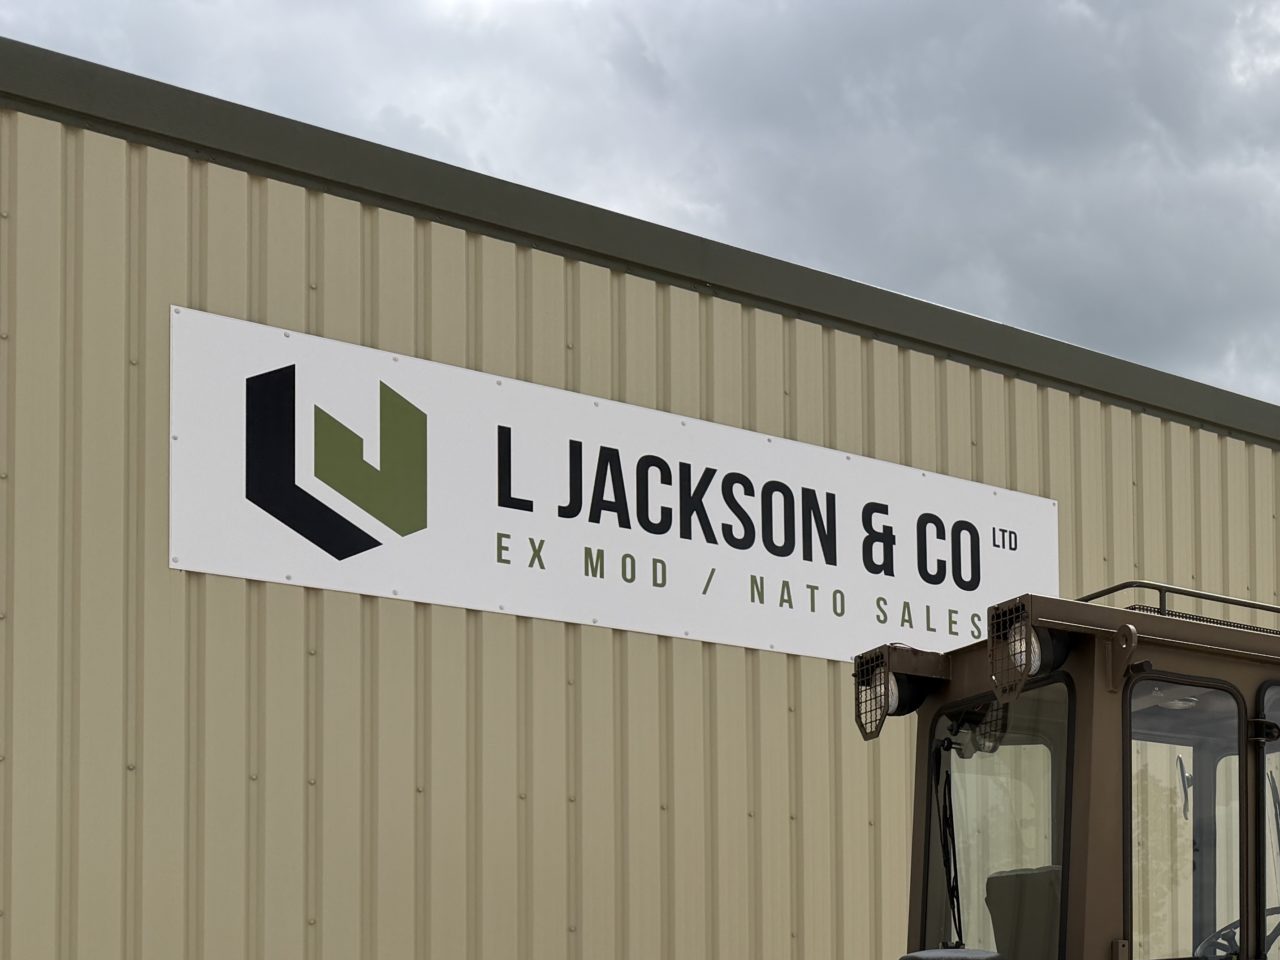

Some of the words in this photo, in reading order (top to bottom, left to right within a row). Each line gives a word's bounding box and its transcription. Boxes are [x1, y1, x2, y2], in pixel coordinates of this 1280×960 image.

[498, 424, 534, 513] L
[557, 439, 838, 567] JACKSON
[861, 501, 897, 578] &
[916, 512, 981, 592] CO
[992, 526, 1019, 552] LTD
[496, 532, 546, 570] EX
[584, 545, 667, 588] MOD
[702, 567, 716, 595] /
[750, 574, 847, 618] NATO
[876, 596, 982, 640] SALES
